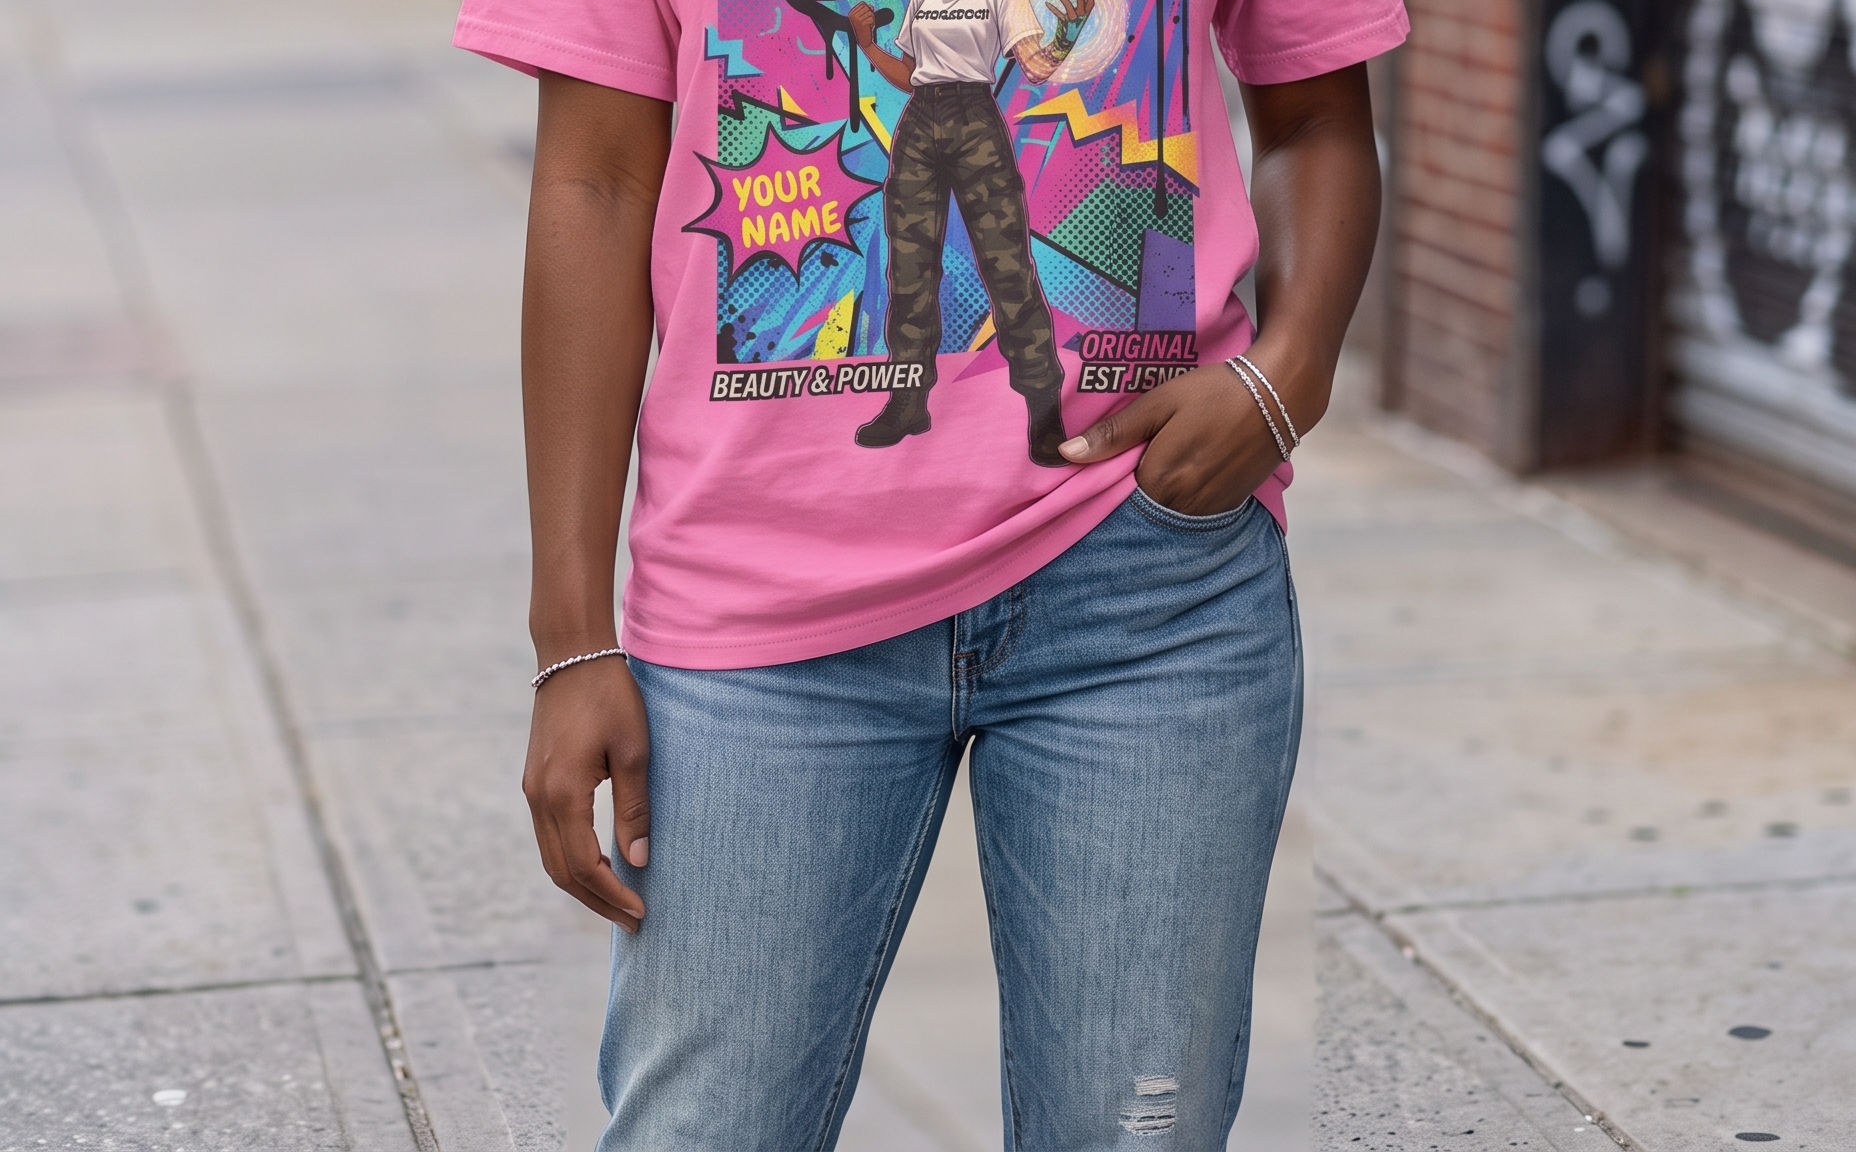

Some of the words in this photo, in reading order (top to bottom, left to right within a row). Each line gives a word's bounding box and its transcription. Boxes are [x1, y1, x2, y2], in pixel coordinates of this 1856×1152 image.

[732, 165, 821, 212] YOUR
[741, 200, 841, 248] NAME
[1082, 333, 1196, 359] ORIGINAL
[712, 369, 808, 399] BEAUTY
[810, 368, 830, 393] &
[836, 362, 924, 392] POWER
[1080, 365, 1126, 391] EST
